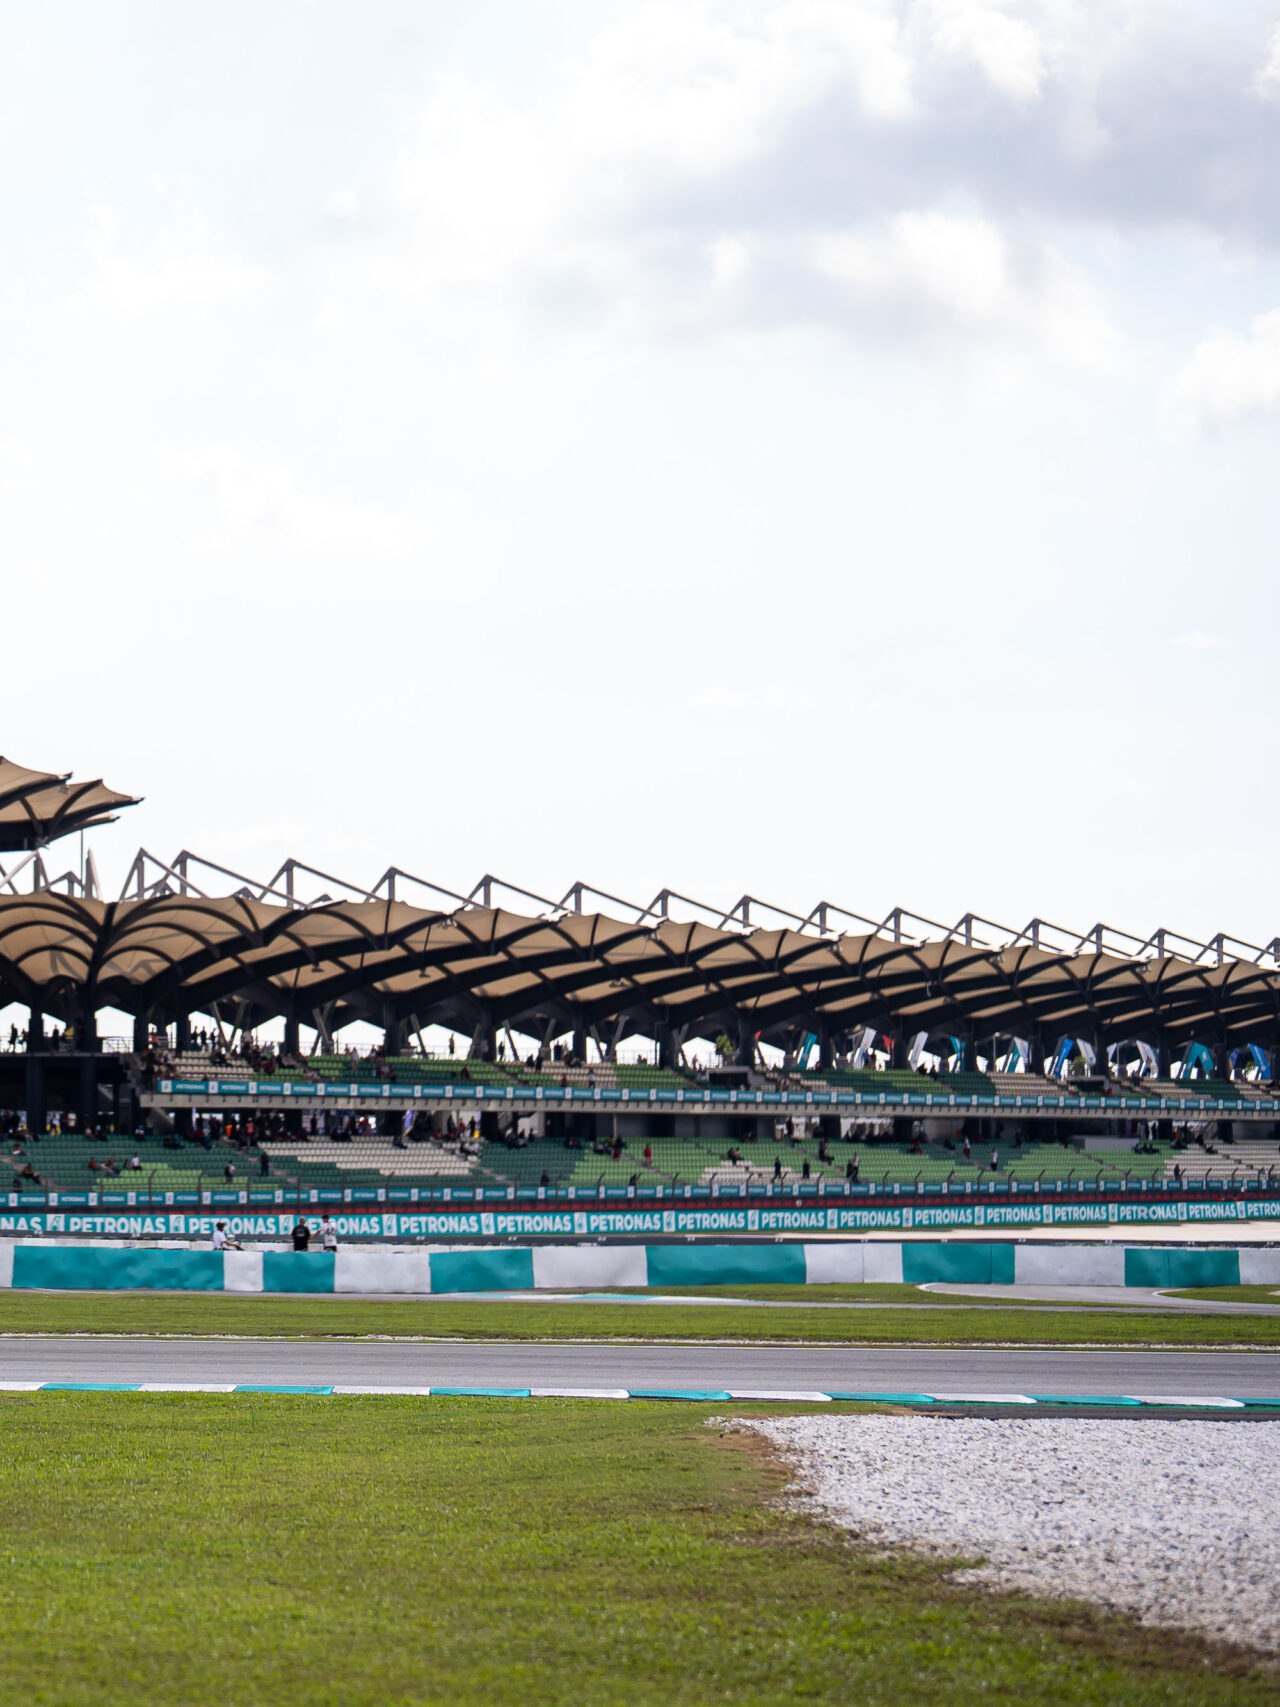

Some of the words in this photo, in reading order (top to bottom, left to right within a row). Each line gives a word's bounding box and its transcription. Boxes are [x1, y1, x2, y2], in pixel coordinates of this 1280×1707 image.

[69, 1217, 166, 1234] PETRONAS
[399, 1216, 479, 1233] PETRONAS
[496, 1215, 572, 1232] PETRONAS
[589, 1214, 661, 1231] PETRONAS
[678, 1213, 745, 1230] PETRONAS
[761, 1212, 825, 1228] PETRONAS
[840, 1210, 901, 1226] PETRONAS
[915, 1209, 973, 1225] PETRONAS
[986, 1207, 1042, 1223] PETRONAS
[1054, 1206, 1107, 1221] PETRONAS
[1119, 1205, 1178, 1220] PETRONAS
[1188, 1203, 1237, 1218] PETRONAS
